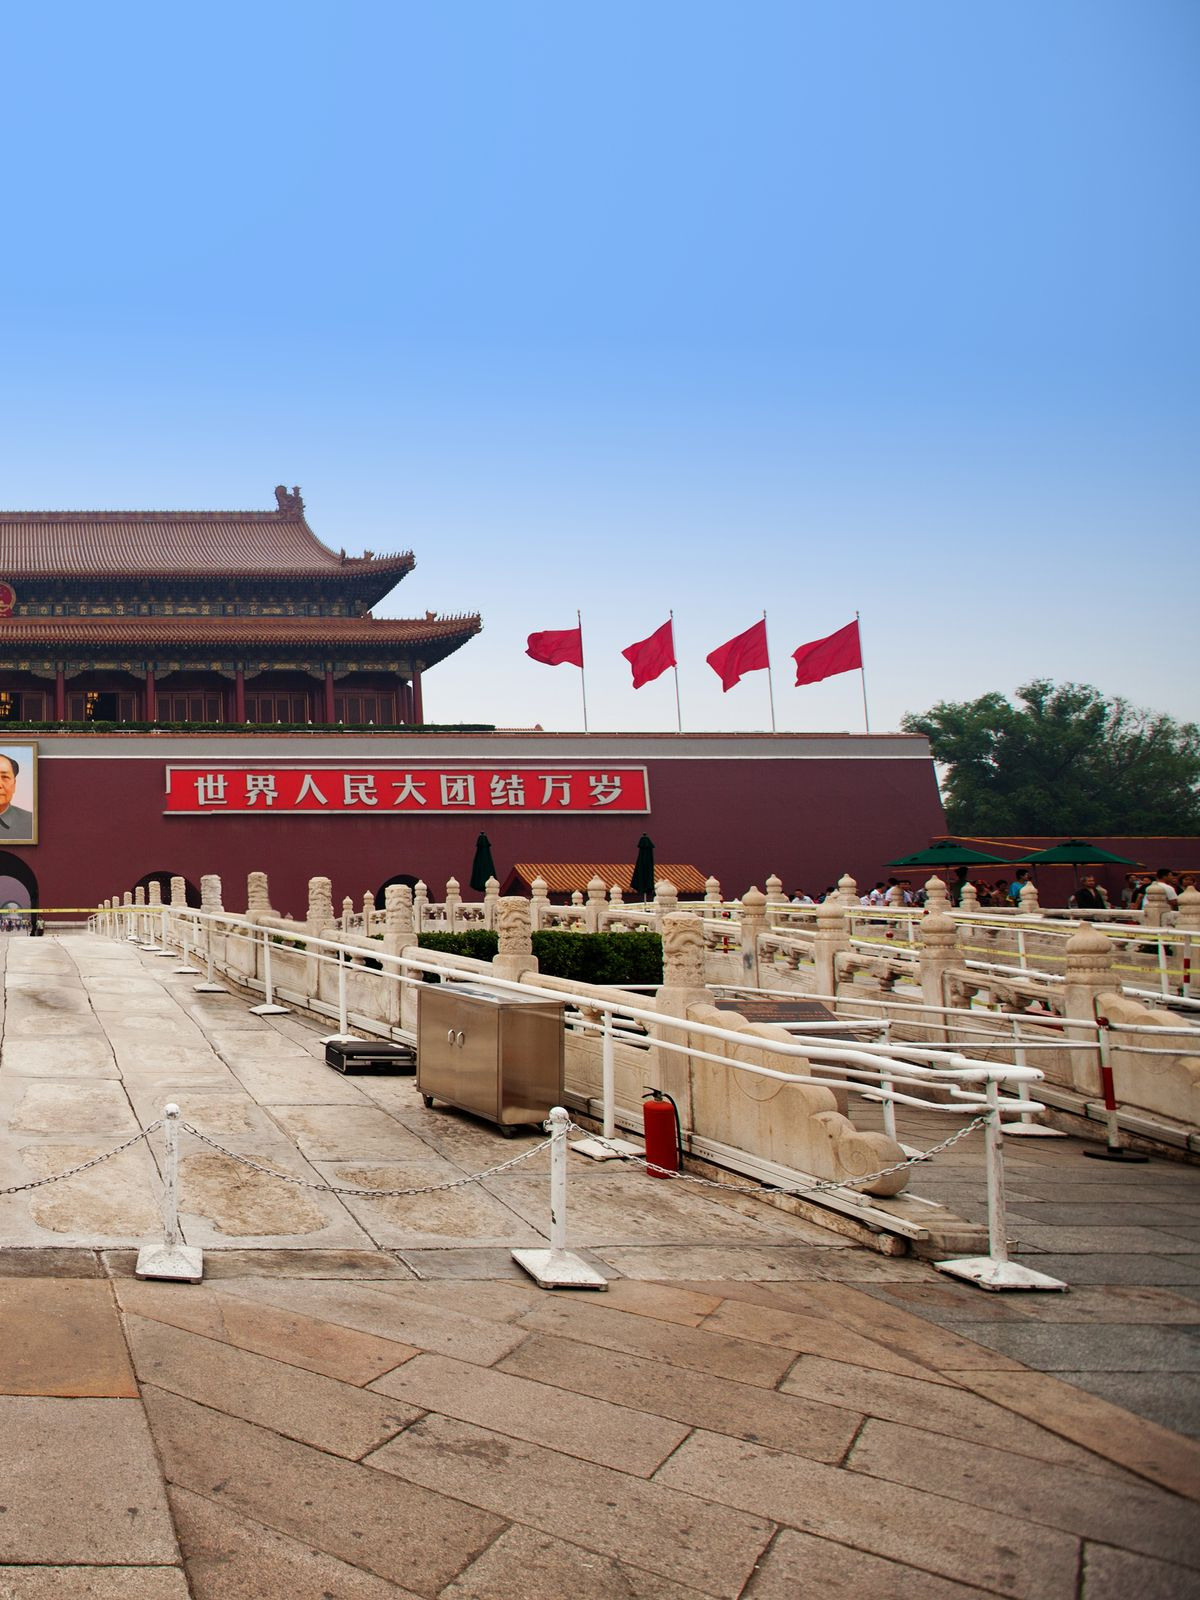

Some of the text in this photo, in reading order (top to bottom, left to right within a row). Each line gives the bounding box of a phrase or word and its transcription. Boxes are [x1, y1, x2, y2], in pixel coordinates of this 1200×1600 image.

[194, 774, 622, 806] 世界人民大团结万岁
